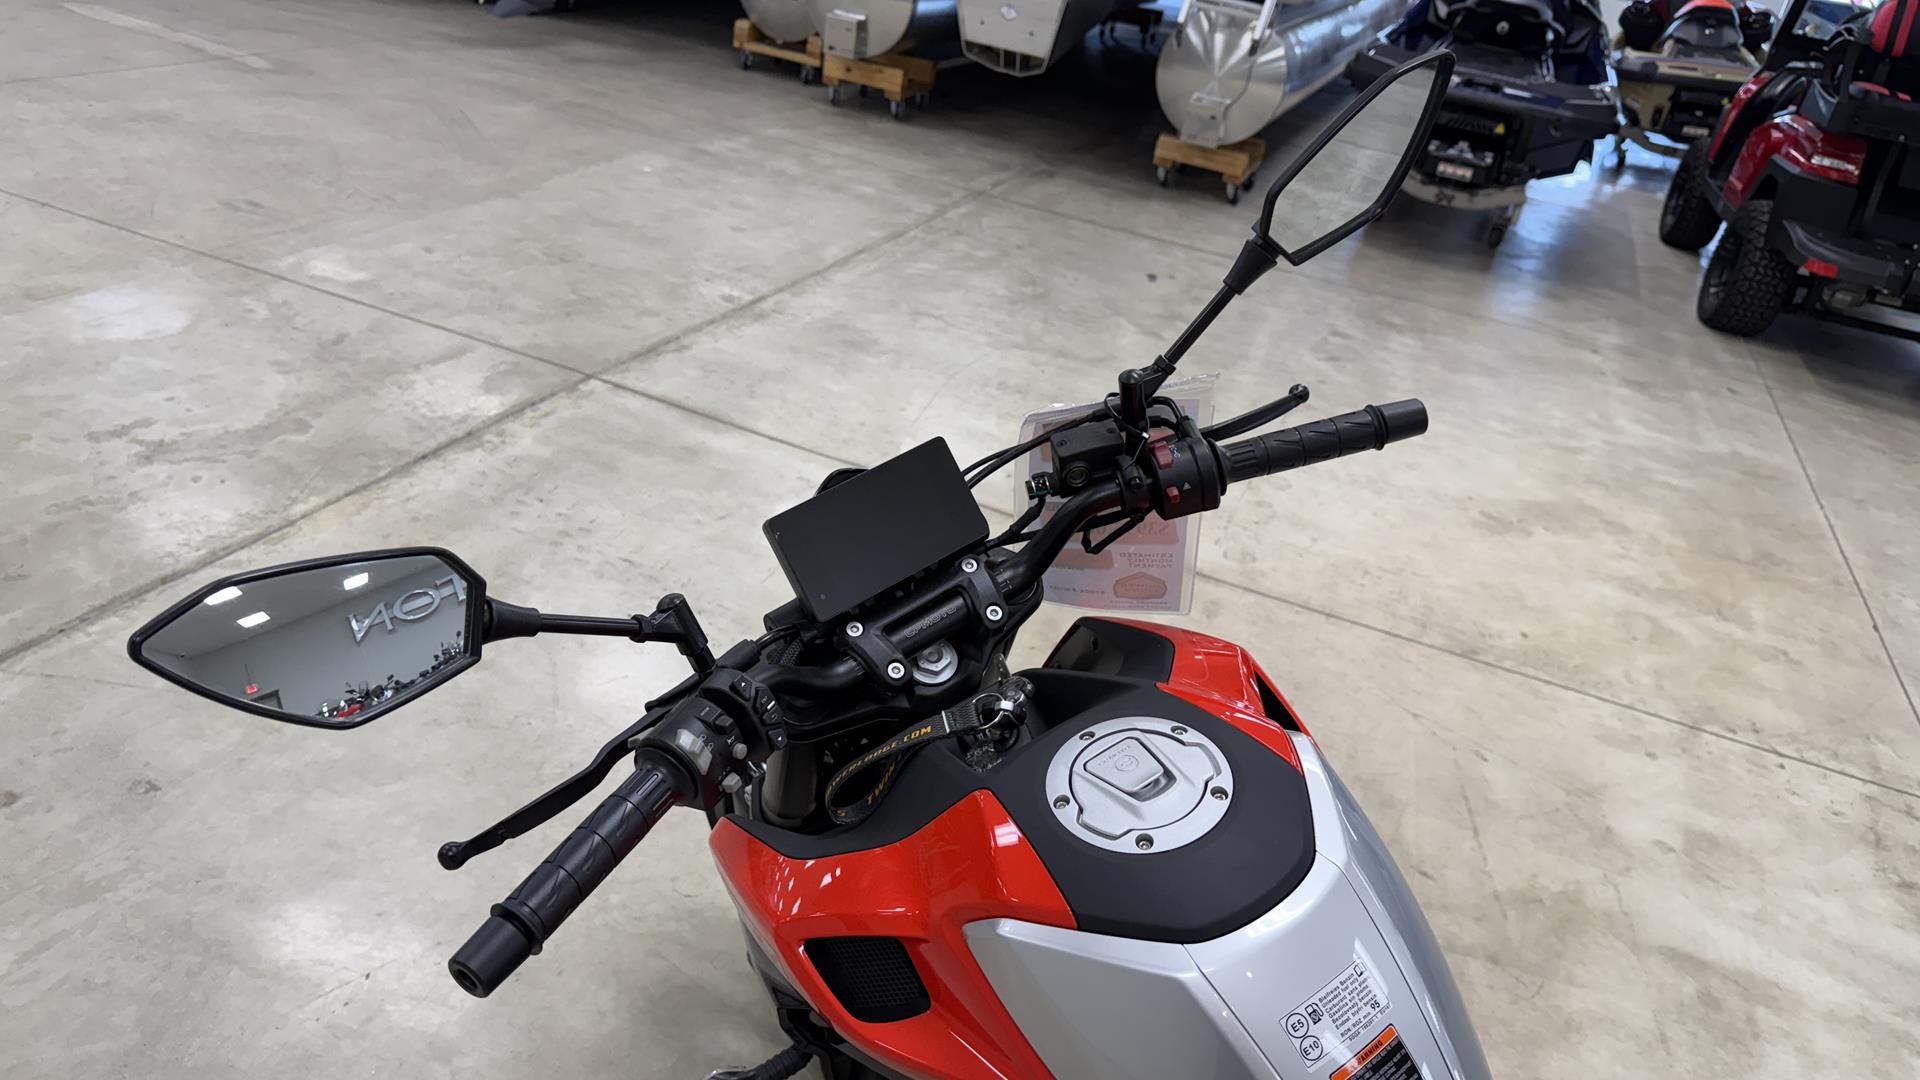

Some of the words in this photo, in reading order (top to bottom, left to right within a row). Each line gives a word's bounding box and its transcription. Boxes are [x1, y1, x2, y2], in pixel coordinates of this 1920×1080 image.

[1369, 999, 1381, 1011] 95
[1291, 1019, 1304, 1032] E5
[1302, 1040, 1319, 1056] E10
